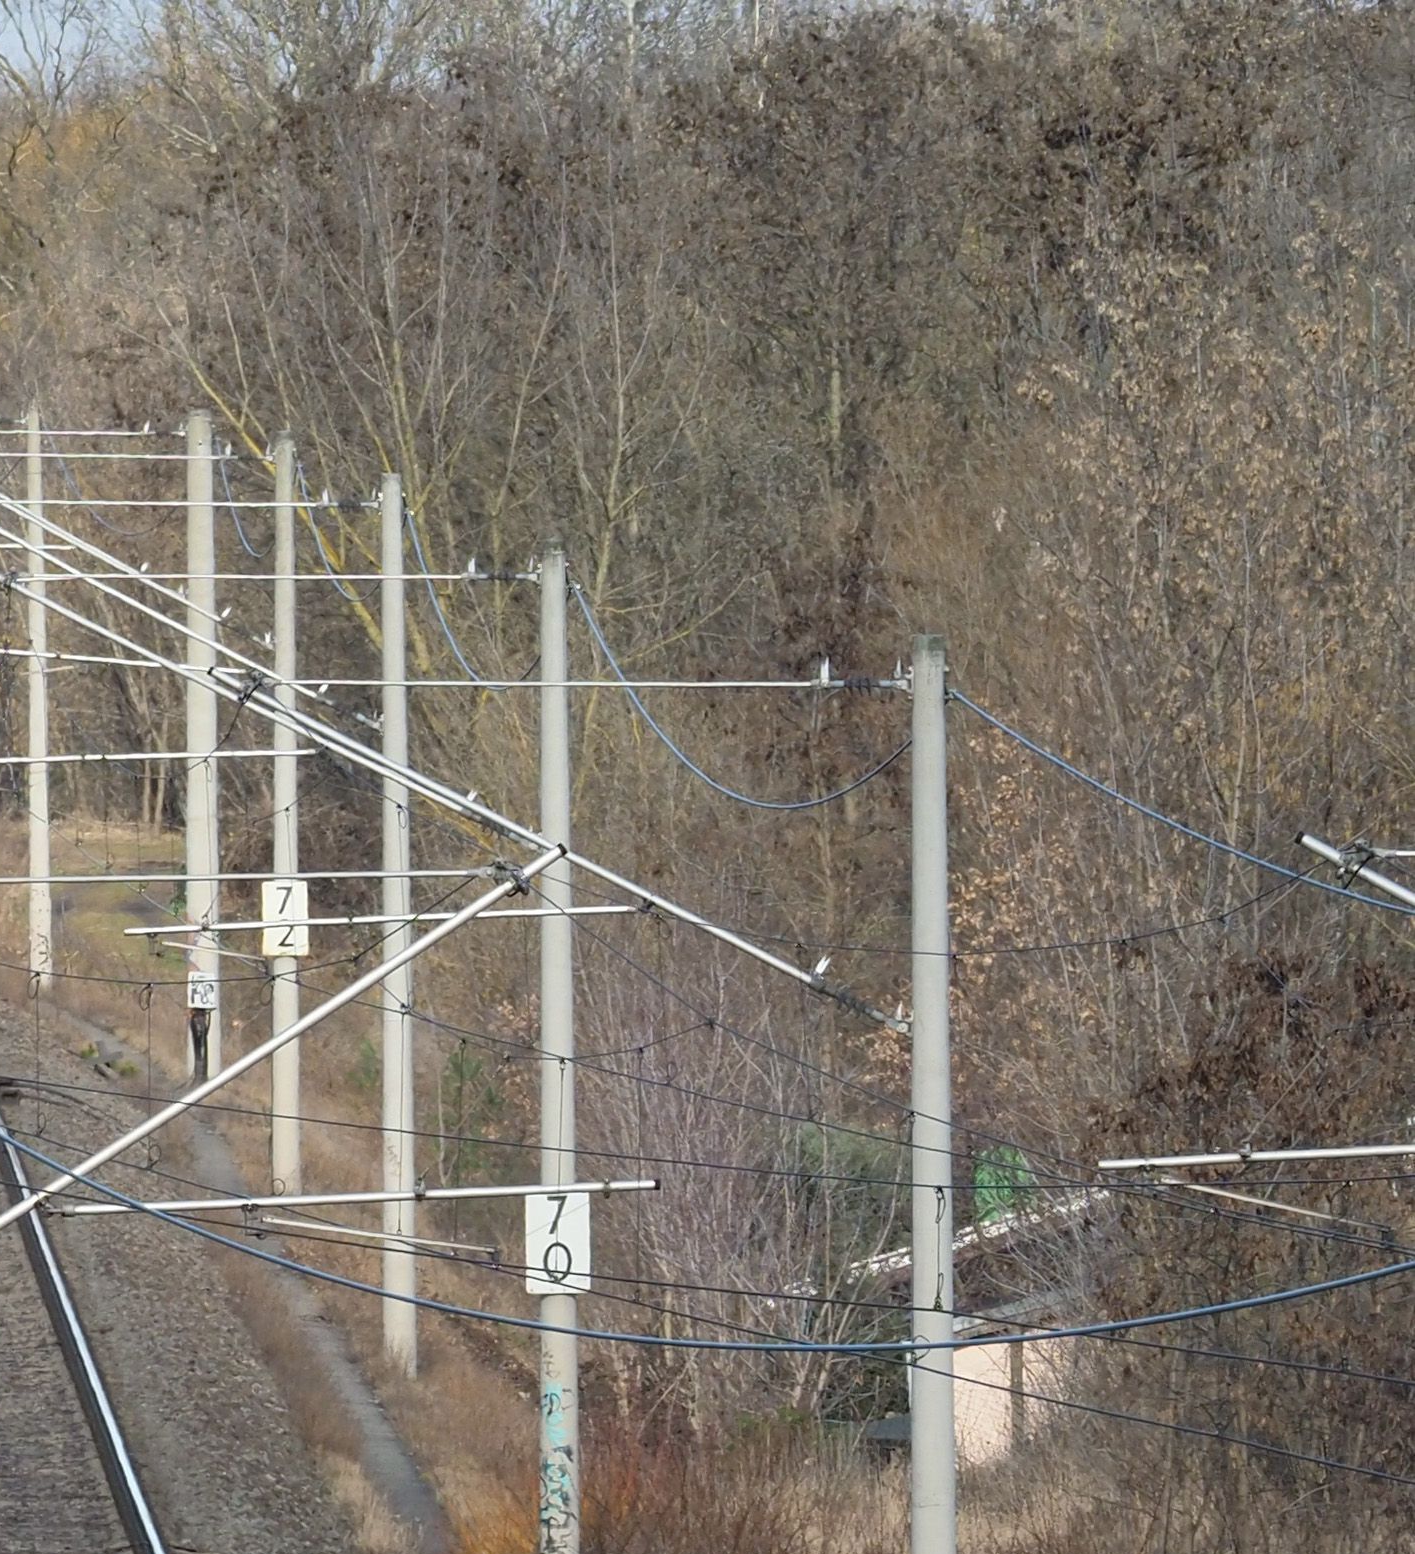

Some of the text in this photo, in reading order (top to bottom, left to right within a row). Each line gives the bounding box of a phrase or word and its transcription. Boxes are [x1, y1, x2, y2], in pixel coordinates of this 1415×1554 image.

[276, 886, 292, 914] 7
[547, 1195, 567, 1234] 7
[543, 1242, 572, 1284] 0
